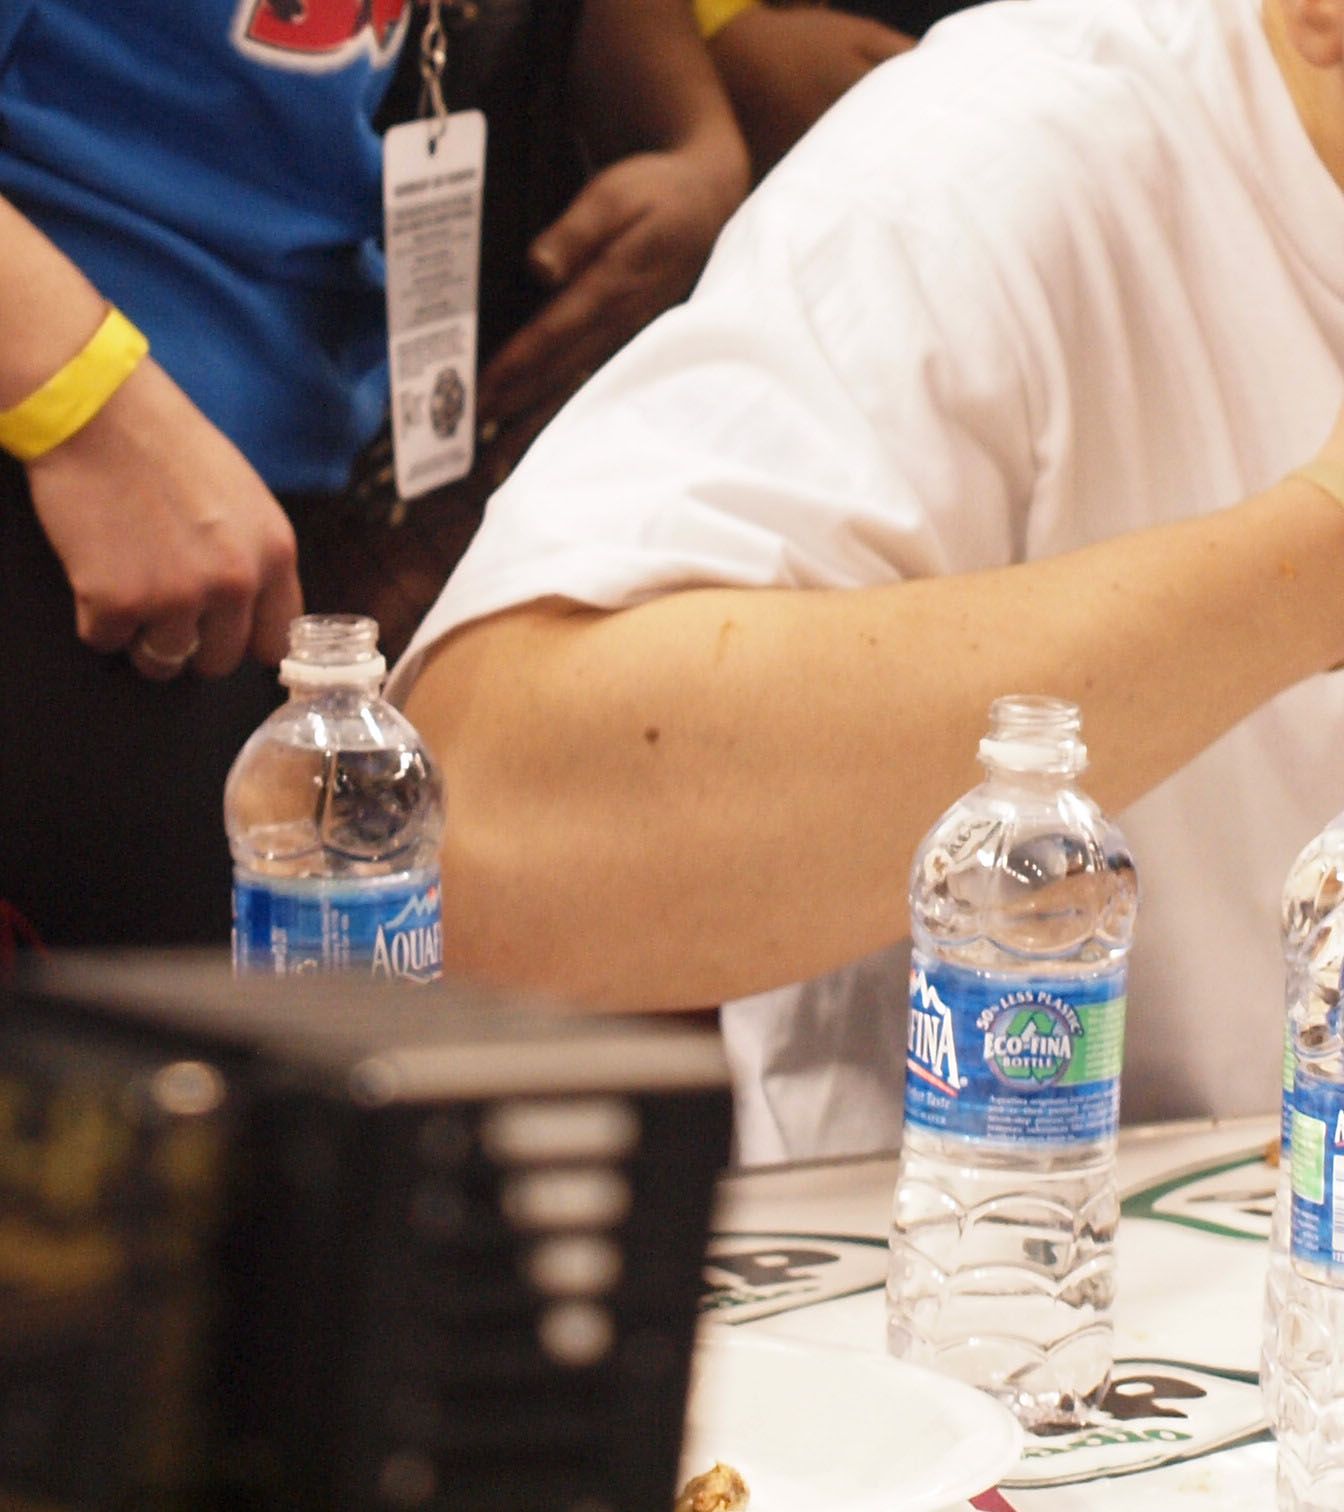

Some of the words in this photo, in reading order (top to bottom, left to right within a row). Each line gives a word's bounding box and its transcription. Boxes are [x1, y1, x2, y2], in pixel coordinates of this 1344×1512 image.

[999, 990, 1034, 1009] LESS
[983, 1031, 1072, 1060] ECO-FINA
[1002, 1057, 1053, 1068] BOTTLE
